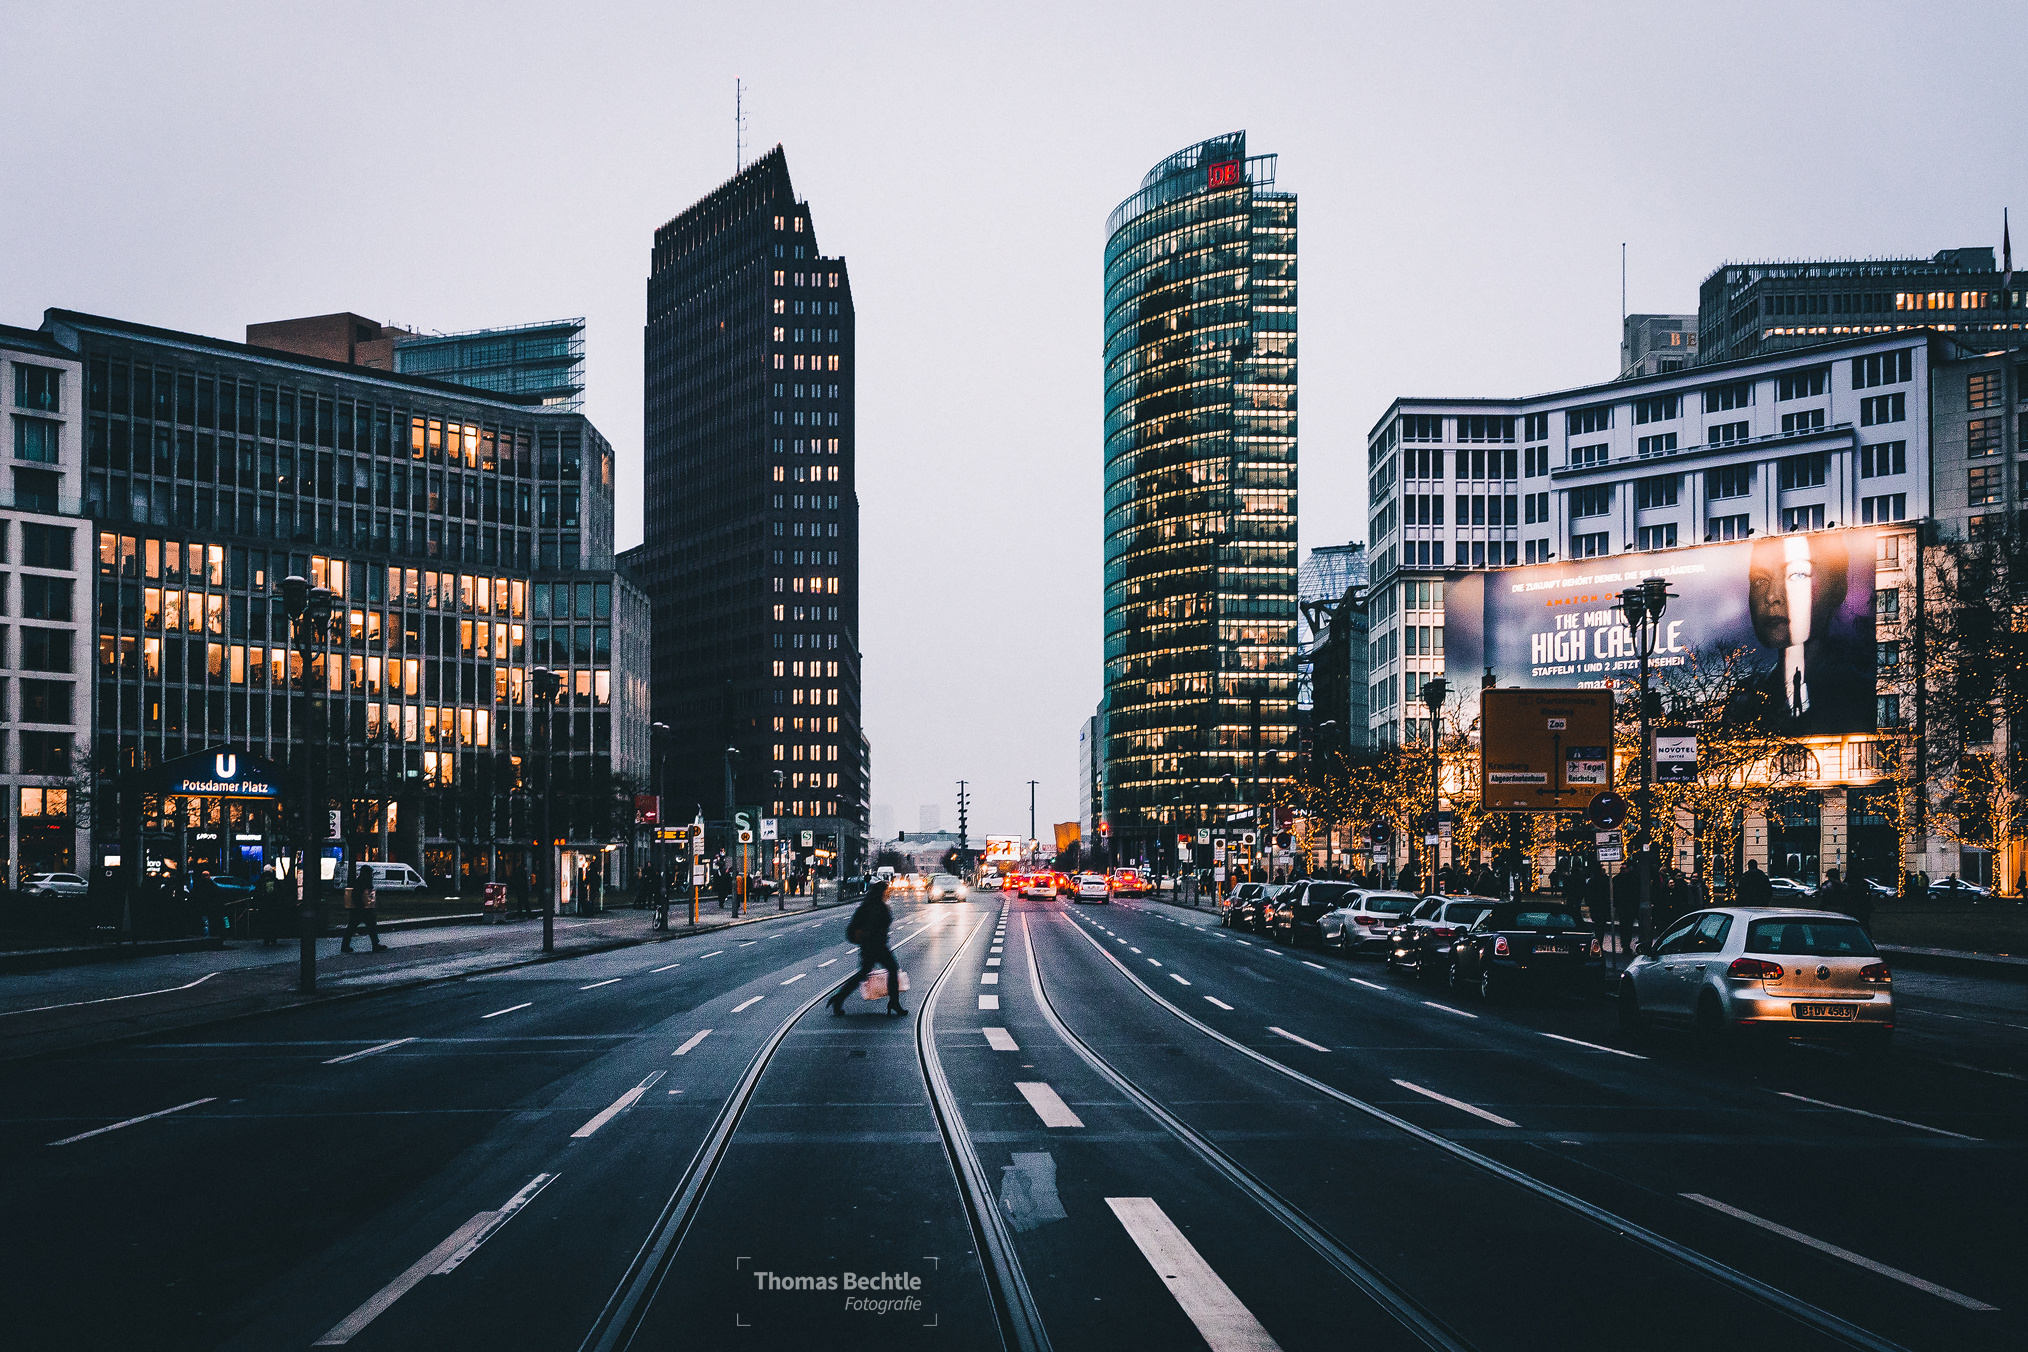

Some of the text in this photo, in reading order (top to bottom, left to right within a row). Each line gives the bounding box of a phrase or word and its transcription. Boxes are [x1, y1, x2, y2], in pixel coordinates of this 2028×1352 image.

[1212, 164, 1236, 185] DB
[1512, 563, 1707, 593] DIE ZUKUNFT GEHÖRT DENEN, DIE SIE VERÄNDERN.
[1546, 594, 1598, 607] AMAZON
[1554, 612, 1580, 631] THE
[1583, 609, 1612, 628] MAN
[1531, 628, 1586, 665] HIGH
[1531, 656, 1685, 677] STAFFELN 1 UND 2 JETZT NSEHEN
[1577, 679, 1621, 689] amazn
[1540, 708, 1574, 717] Wedding
[1549, 720, 1565, 728] Zoo
[215, 753, 236, 779] U
[1488, 762, 1530, 771] Kreuzberg
[1583, 763, 1605, 772] Tegel
[182, 779, 269, 793] Potsdamer Platz
[1568, 775, 1597, 784] Reichstag
[735, 811, 751, 831] S
